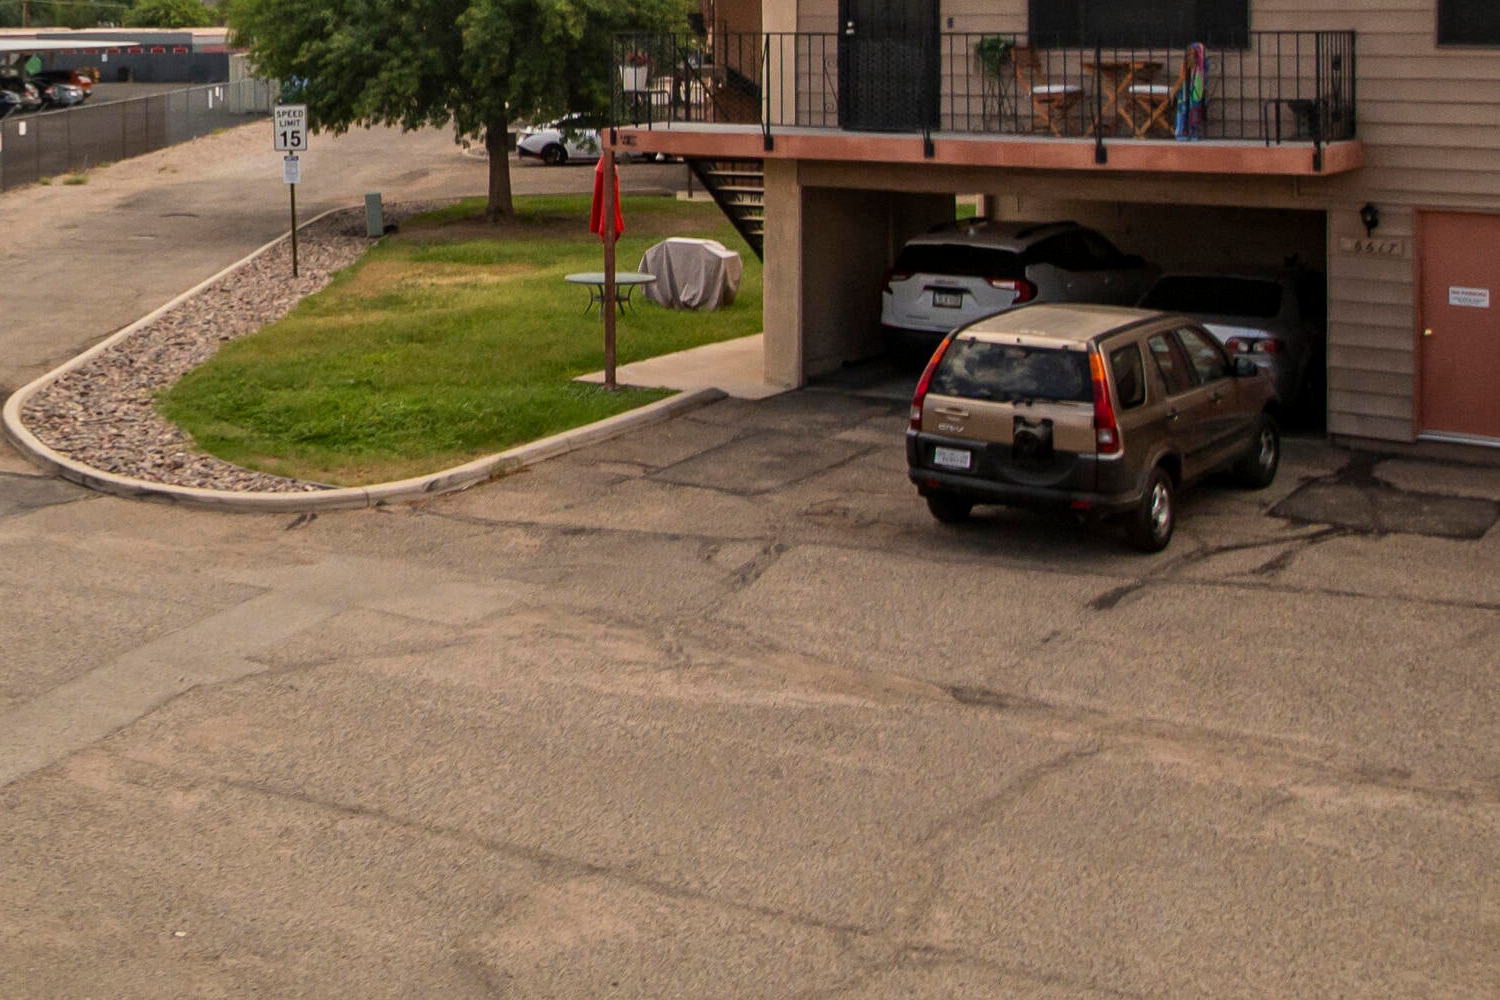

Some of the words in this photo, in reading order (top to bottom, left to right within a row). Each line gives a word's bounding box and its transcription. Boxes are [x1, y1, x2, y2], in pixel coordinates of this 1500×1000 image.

[276, 110, 304, 118] SPEED
[279, 119, 301, 127] LIMIT
[280, 130, 301, 147] 15
